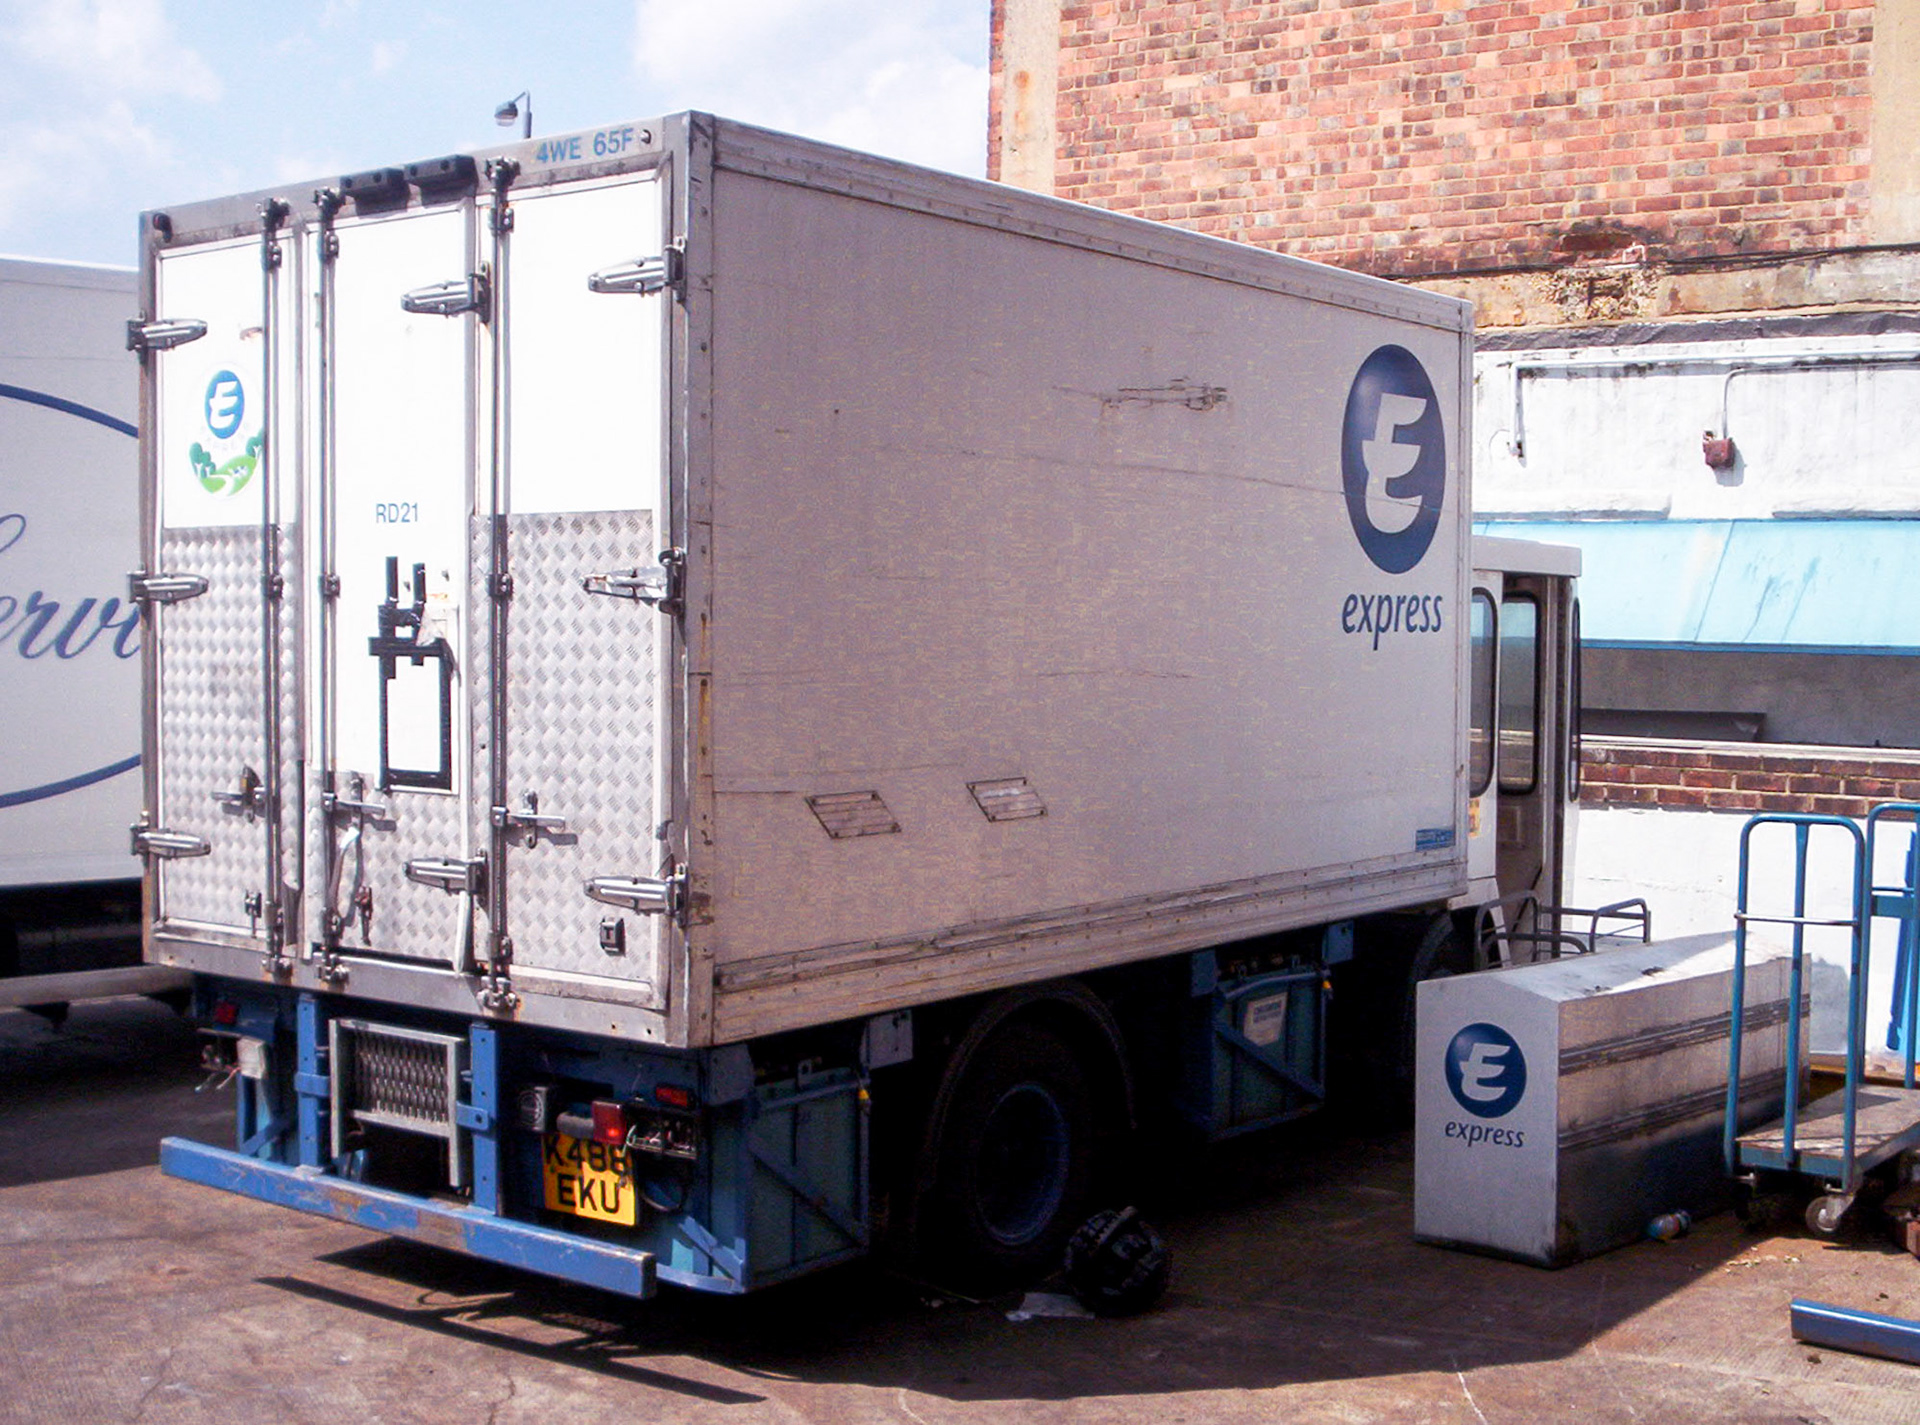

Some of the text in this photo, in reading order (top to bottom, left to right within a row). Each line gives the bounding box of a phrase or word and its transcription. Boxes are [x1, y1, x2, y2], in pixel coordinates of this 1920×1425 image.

[536, 127, 634, 163] 4WE 65F
[376, 501, 418, 524] RD21
[1341, 591, 1443, 651] express
[1445, 1120, 1525, 1148] express
[557, 1173, 620, 1214] EKU
